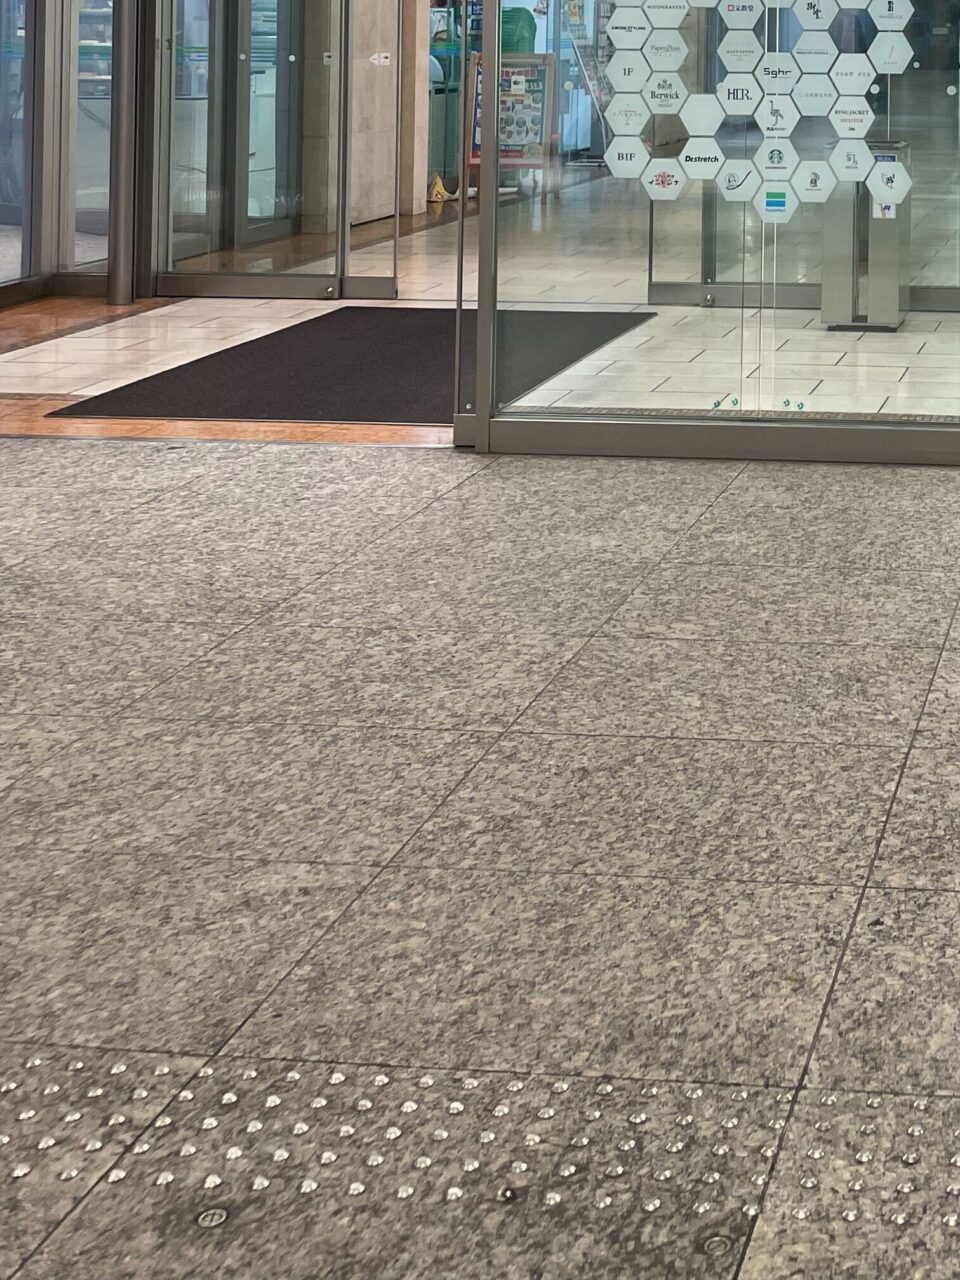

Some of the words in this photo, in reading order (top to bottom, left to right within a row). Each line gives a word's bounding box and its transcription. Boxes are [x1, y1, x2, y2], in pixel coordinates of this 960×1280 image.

[623, 67, 634, 76] 1F
[763, 67, 792, 79] Sghr
[650, 90, 680, 100] Berwick
[617, 152, 636, 161] B1F
